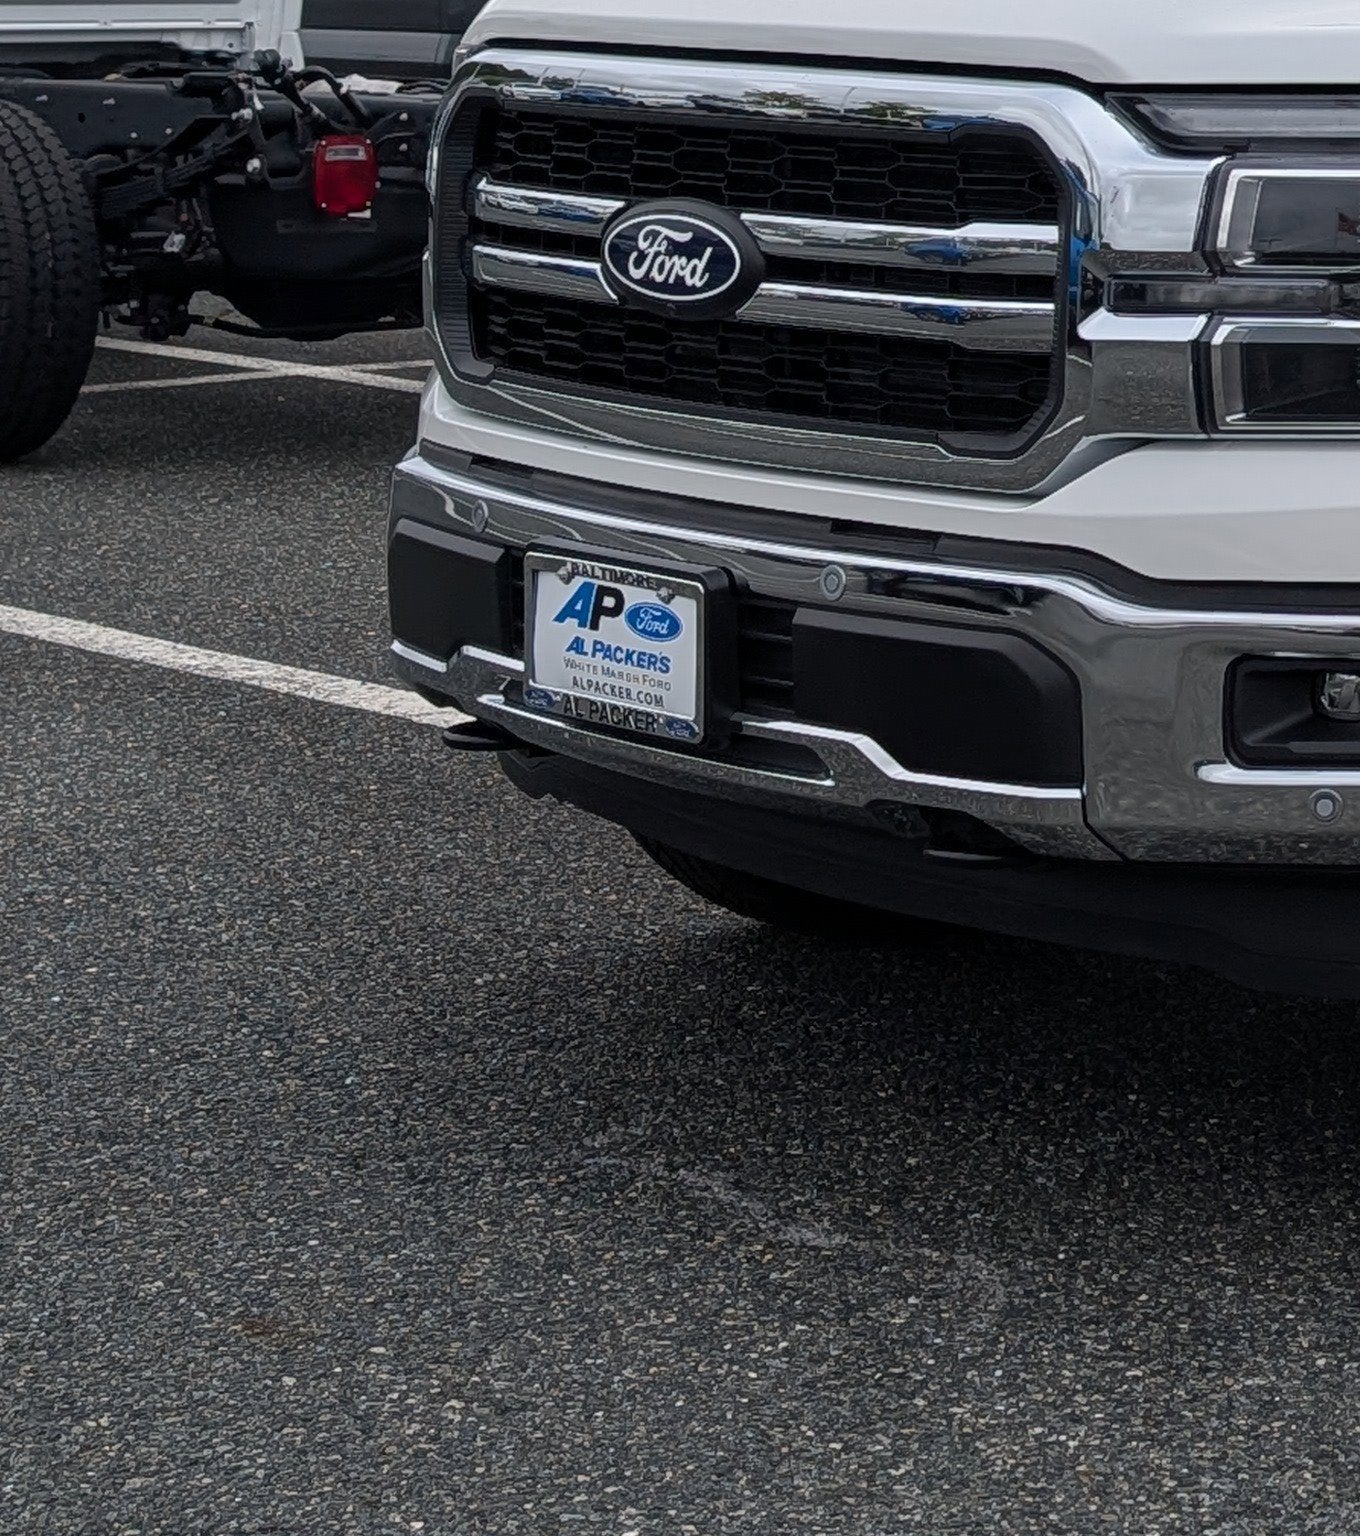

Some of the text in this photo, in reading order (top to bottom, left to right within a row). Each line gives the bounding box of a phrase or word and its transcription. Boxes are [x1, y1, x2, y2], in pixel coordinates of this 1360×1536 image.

[628, 225, 714, 287] Ford
[552, 581, 669, 635] AP Ford
[565, 635, 671, 674] AL PACKER'S
[572, 676, 665, 708] ALPACKER.COM
[563, 693, 657, 733] AL PACKER
